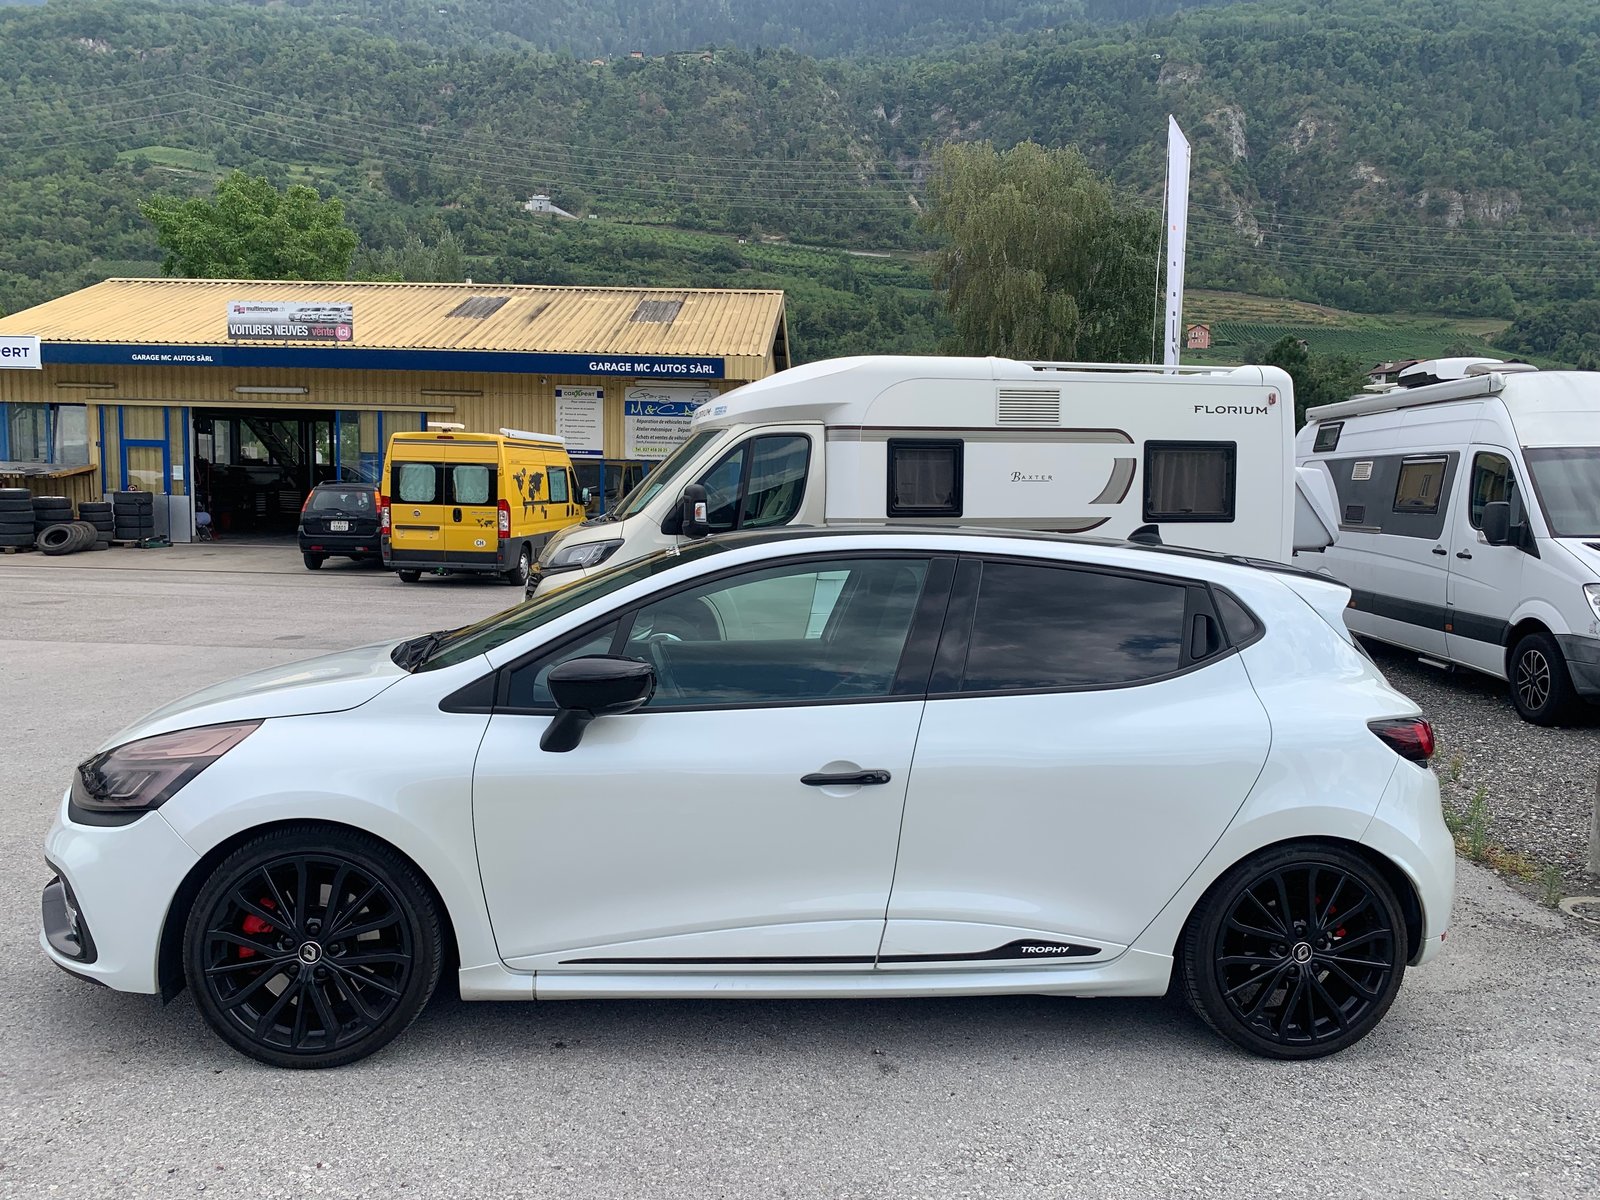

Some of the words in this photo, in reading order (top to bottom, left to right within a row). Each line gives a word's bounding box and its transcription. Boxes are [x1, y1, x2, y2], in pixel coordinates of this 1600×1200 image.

[229, 324, 273, 335] VOITURES
[274, 325, 309, 336] NEUVES
[311, 327, 334, 337] vente
[338, 326, 348, 337] ici
[131, 353, 160, 361] GARAGE
[173, 354, 196, 362] AUTOS
[589, 362, 632, 372] GARAGE
[634, 363, 651, 372] MC
[653, 363, 687, 373] AUTOS
[689, 363, 715, 374] SÀRL
[1193, 405, 1268, 415] FLORIUM
